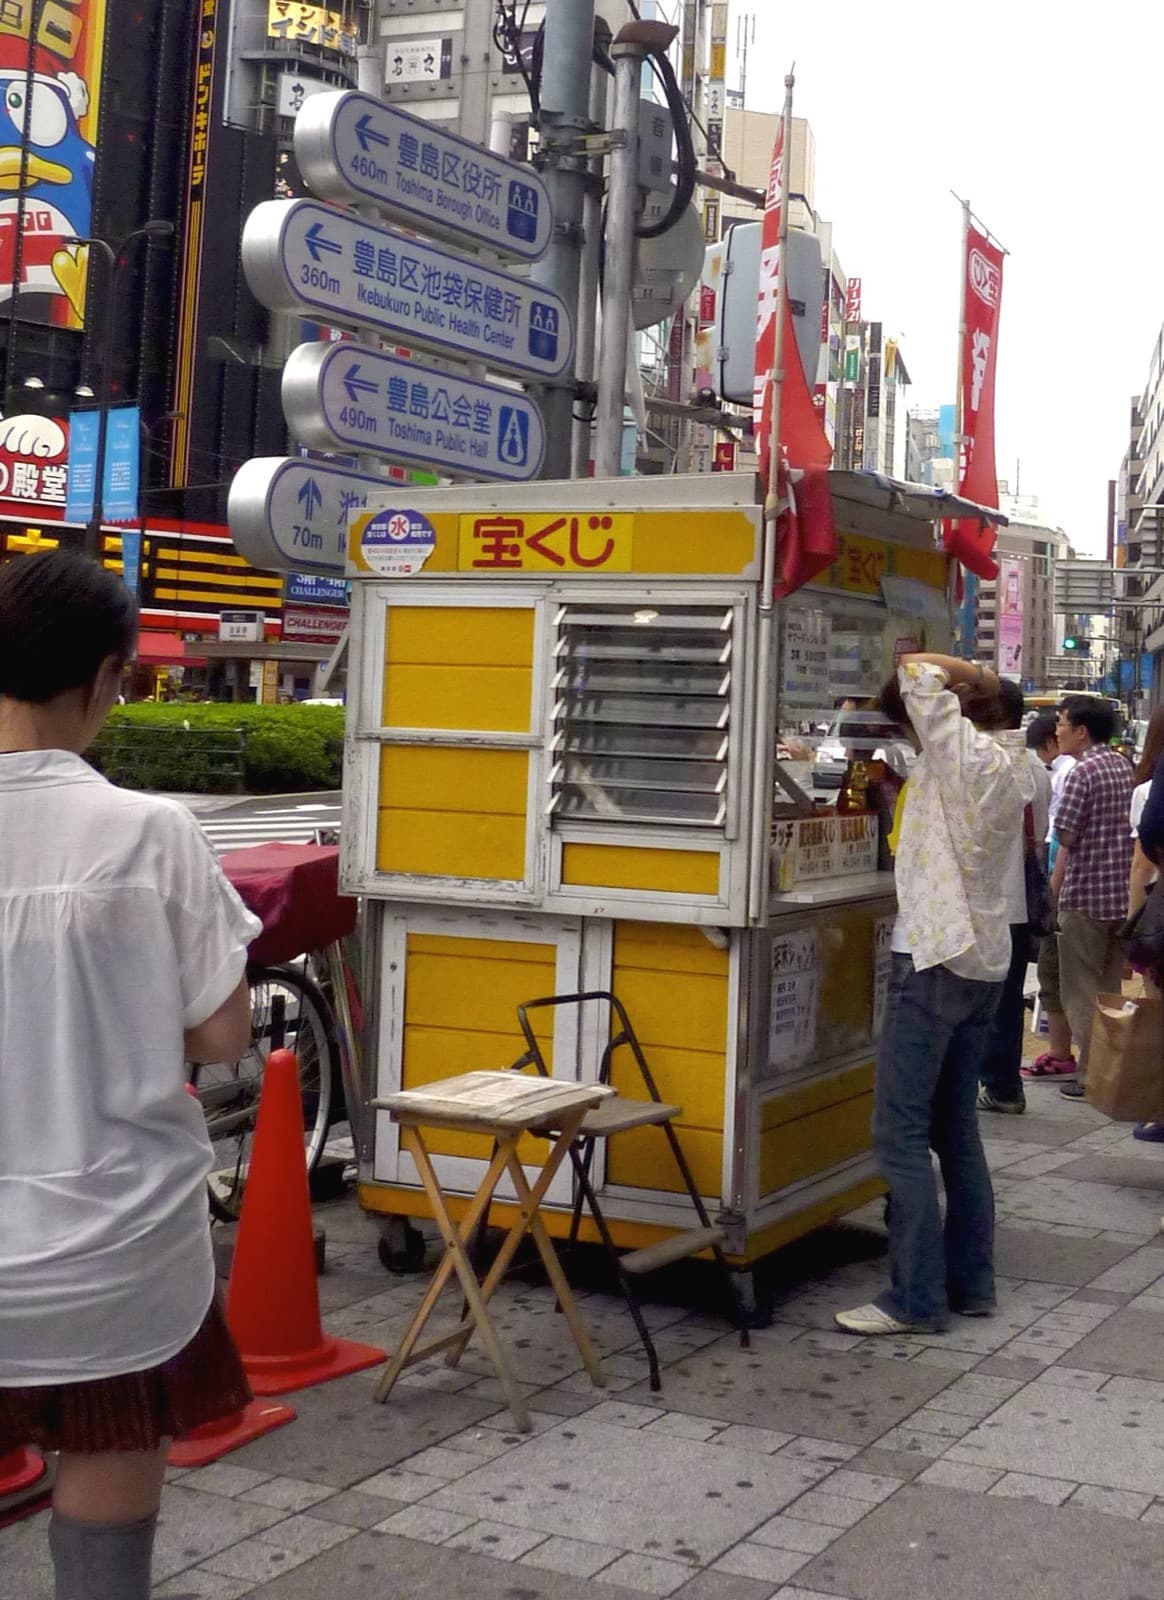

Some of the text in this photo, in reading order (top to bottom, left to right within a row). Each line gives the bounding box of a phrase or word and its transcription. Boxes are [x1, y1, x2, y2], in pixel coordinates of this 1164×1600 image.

[351, 155, 388, 185] 460m
[397, 132, 502, 204] 豊島区役所
[395, 171, 501, 230] Toshima Borough Office
[301, 264, 341, 294] 360m
[353, 239, 522, 328] 豊島区池袋保健所
[357, 282, 515, 350] Ikebukuro Public Health Center
[339, 406, 377, 432] 490m
[387, 375, 492, 435] 豊島公会堂
[388, 417, 489, 459] Toshima Public Hall
[292, 525, 323, 549] 70m
[390, 516, 408, 537] 水
[472, 516, 615, 568] 宝くじ
[290, 585, 345, 598] CHALLENGER
